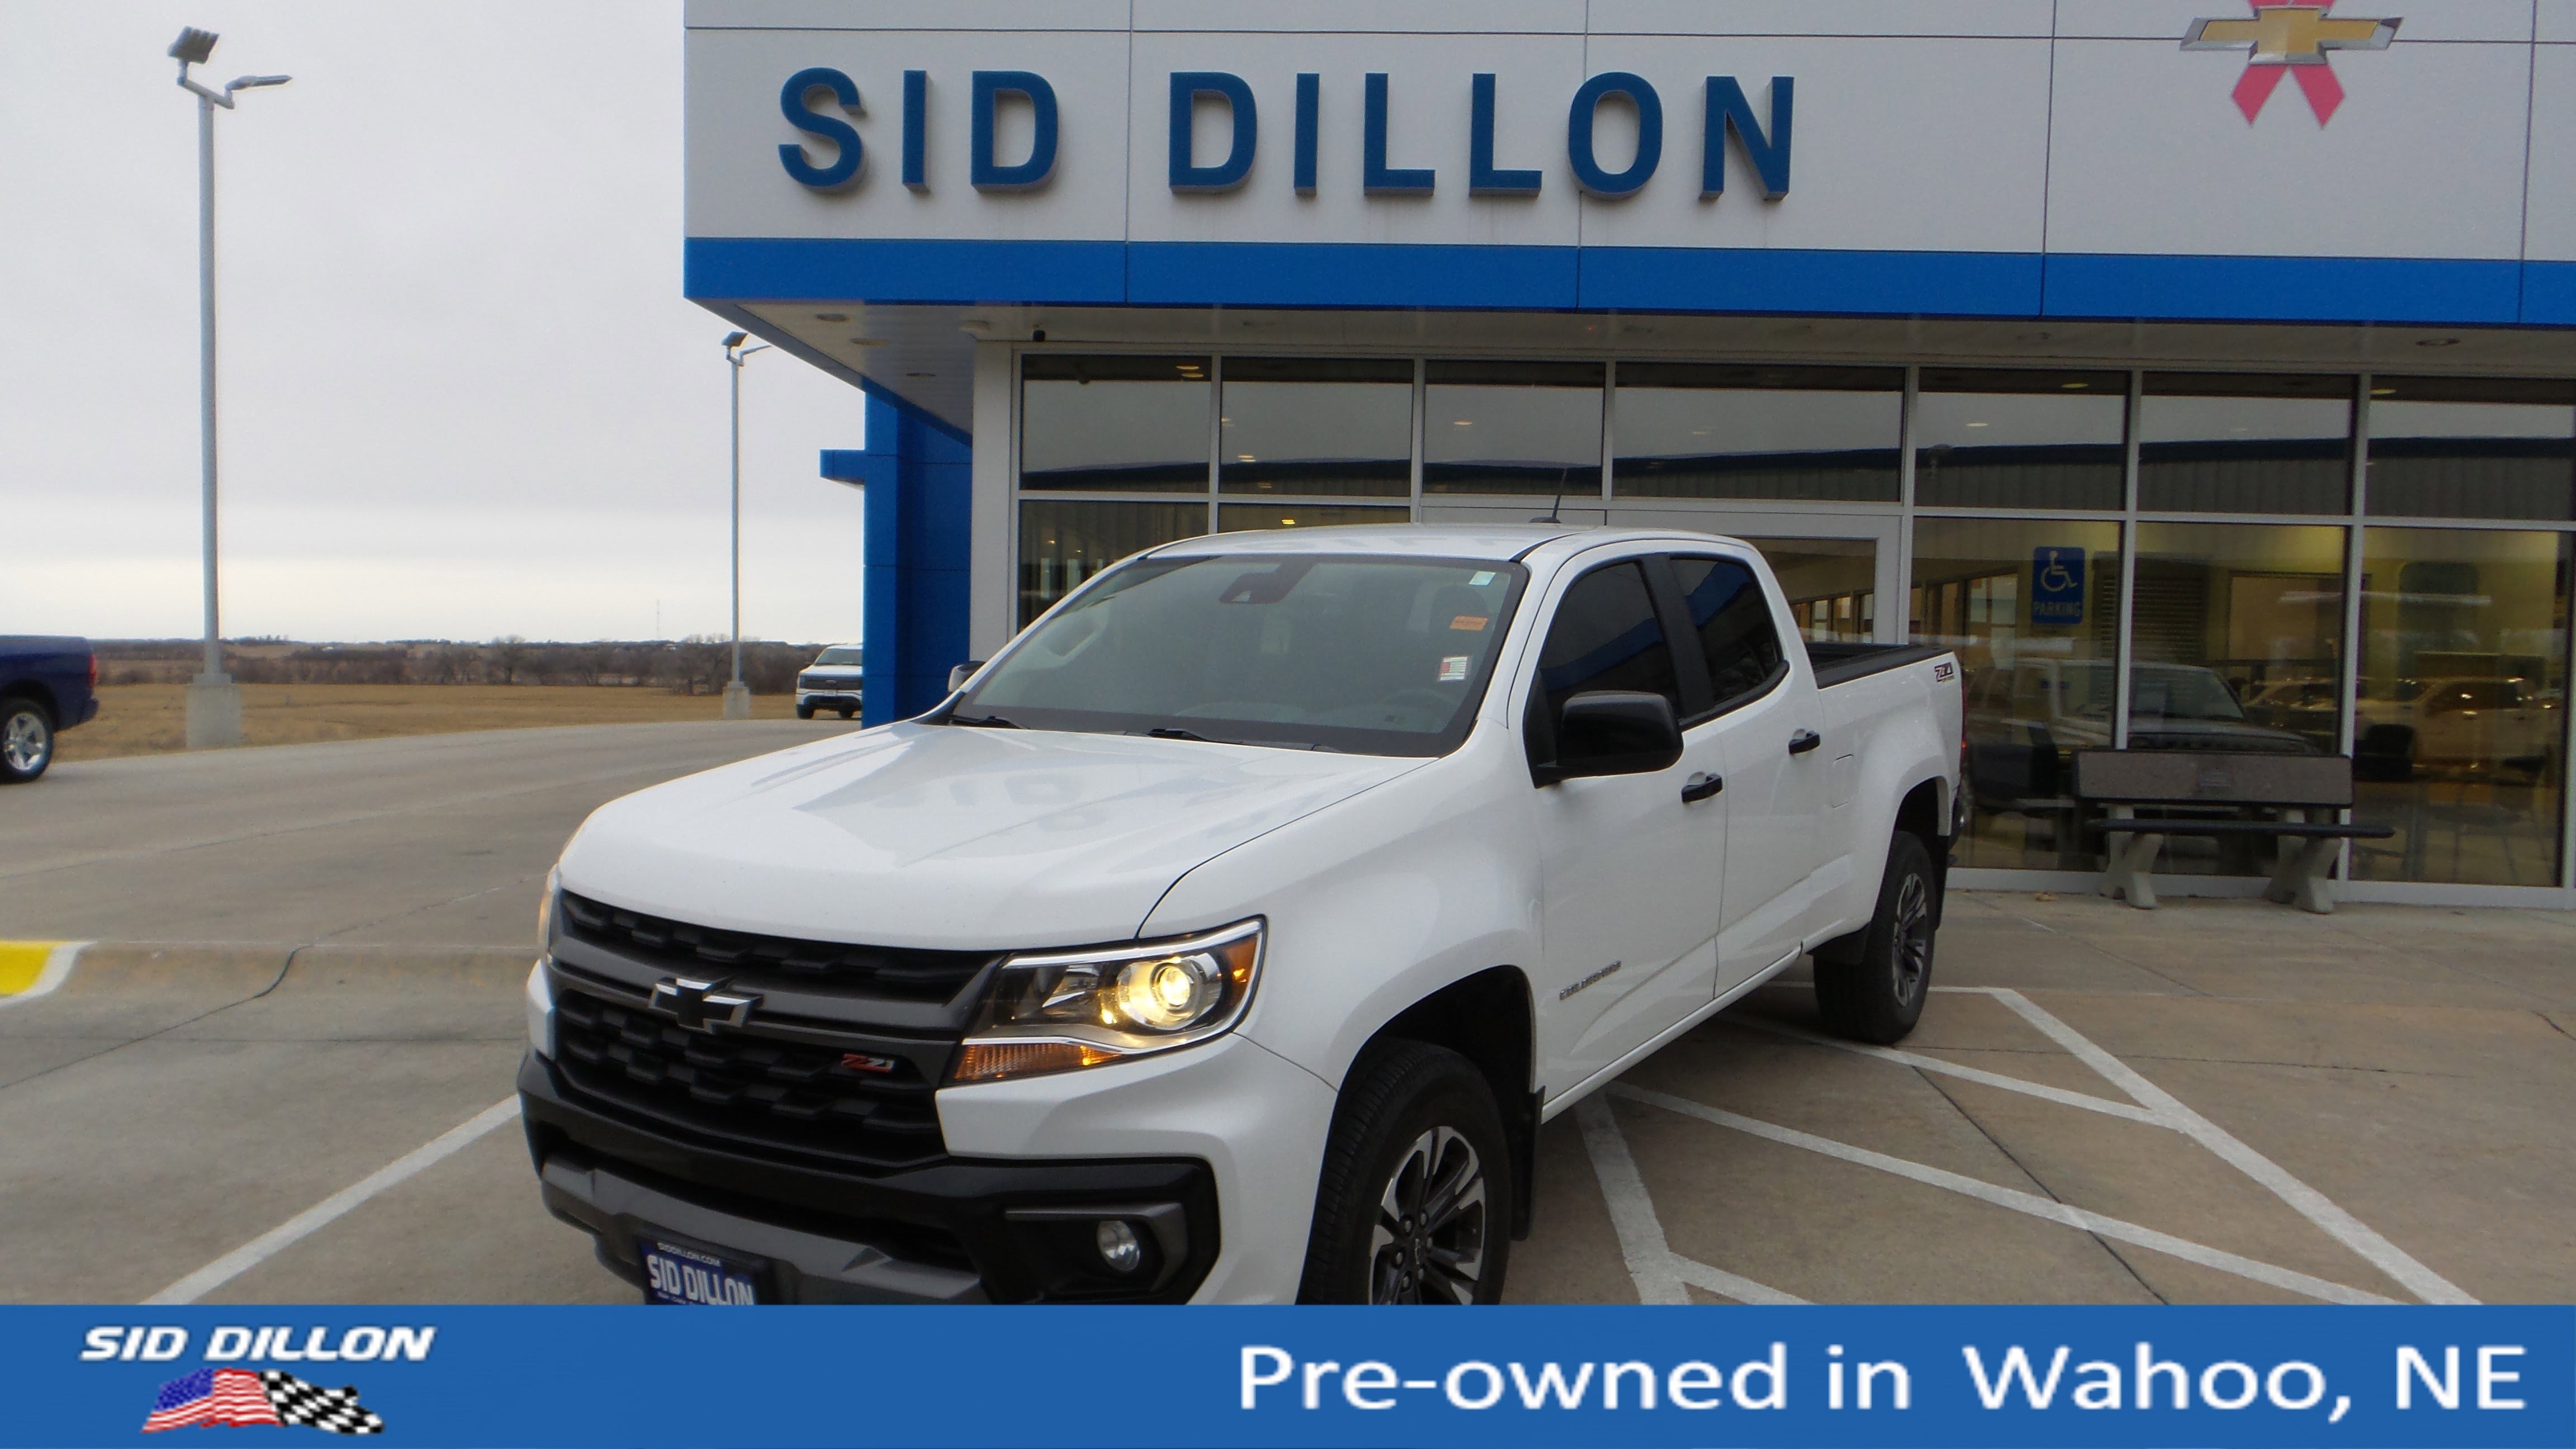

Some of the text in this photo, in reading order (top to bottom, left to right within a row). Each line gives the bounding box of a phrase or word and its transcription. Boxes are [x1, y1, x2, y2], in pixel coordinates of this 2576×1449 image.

[778, 67, 1794, 200] SID DILLON
[2034, 601, 2081, 617] PARKING
[841, 1054, 896, 1073] Z71
[647, 1254, 755, 1305] SID DILLON
